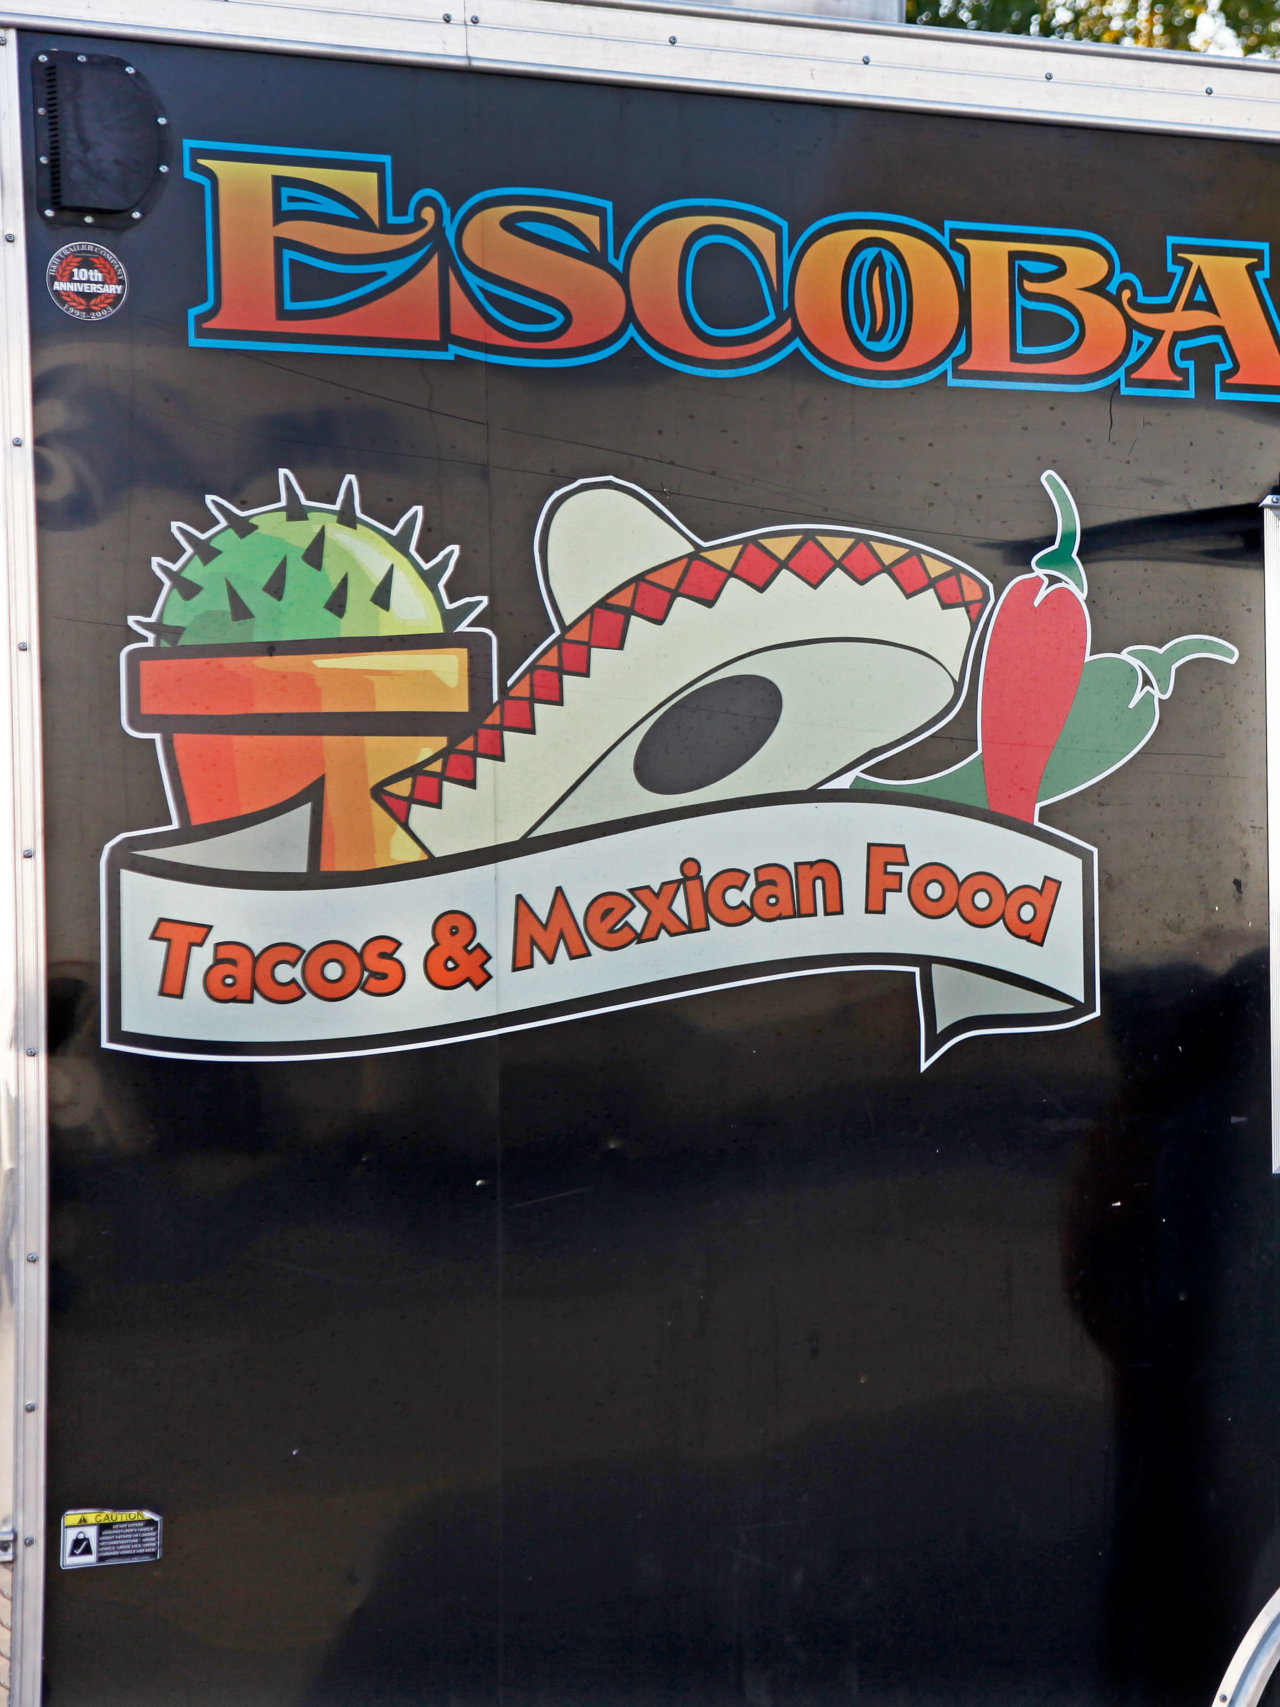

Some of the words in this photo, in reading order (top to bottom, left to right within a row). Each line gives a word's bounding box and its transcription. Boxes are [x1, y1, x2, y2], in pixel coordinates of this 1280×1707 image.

[71, 268, 104, 281] 10th
[53, 281, 123, 294] ANNIVERSARY
[149, 916, 402, 1004] Tacos
[423, 909, 492, 991] &
[511, 857, 843, 972] Mexican
[863, 842, 1063, 946] Food
[95, 1511, 144, 1523] CAUTION
